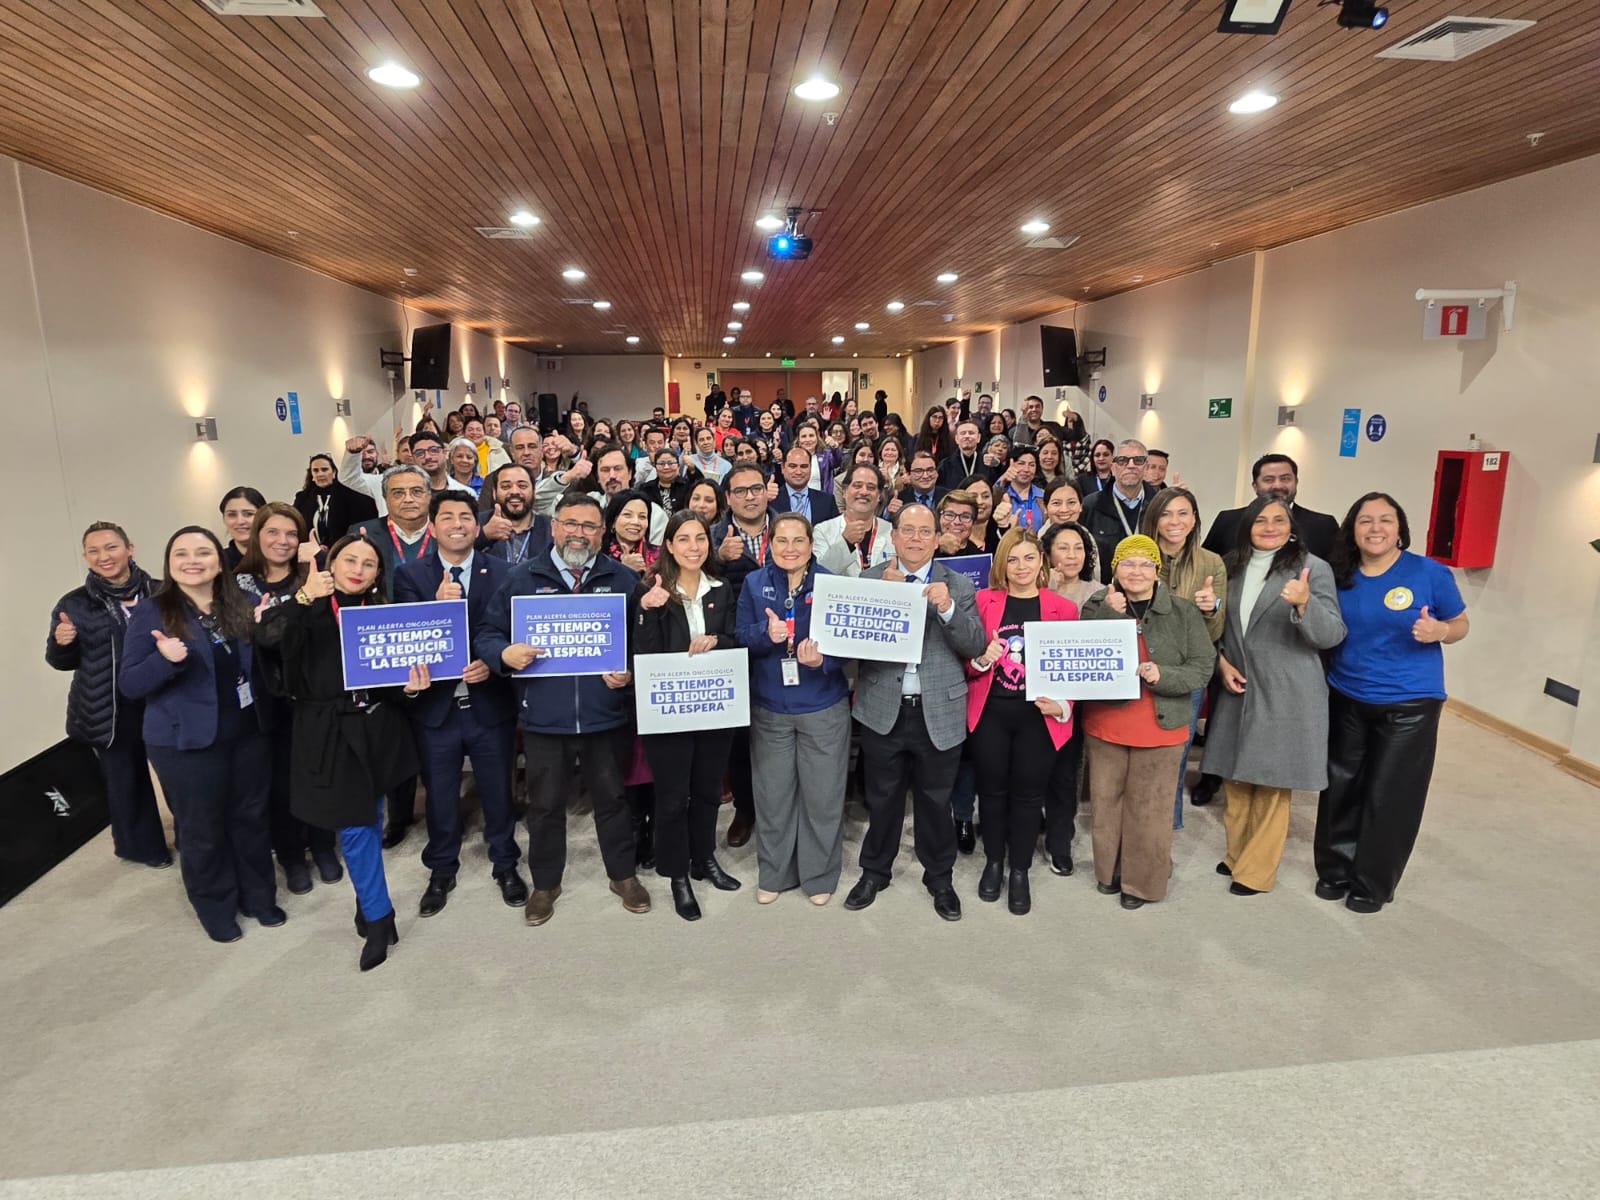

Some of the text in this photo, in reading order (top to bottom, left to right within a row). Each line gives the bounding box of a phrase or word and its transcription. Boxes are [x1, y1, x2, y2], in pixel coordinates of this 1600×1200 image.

[845, 594, 868, 602] ALERTA
[836, 603, 901, 619] ES TIEMPO
[378, 622, 404, 630] ALERTA
[535, 621, 602, 633] ES TIEMPO
[829, 614, 904, 632] DE REDUCIR
[369, 629, 443, 645] ES TIEMPO
[531, 633, 606, 645] DE REDUCIR
[833, 628, 897, 643] LA ESPERA
[364, 640, 447, 657] DE REDUCIR
[554, 646, 602, 658] ESPERA
[1049, 647, 1114, 658] ES TIEMPO
[371, 653, 443, 670] LA ESPERA
[1044, 659, 1118, 670] DE REDUCIR
[1050, 672, 1114, 682] LA ESPERA
[660, 678, 725, 691] ES TIEMPO
[655, 689, 729, 703] DE REDUCIR
[661, 702, 725, 715] LA ESPERA
